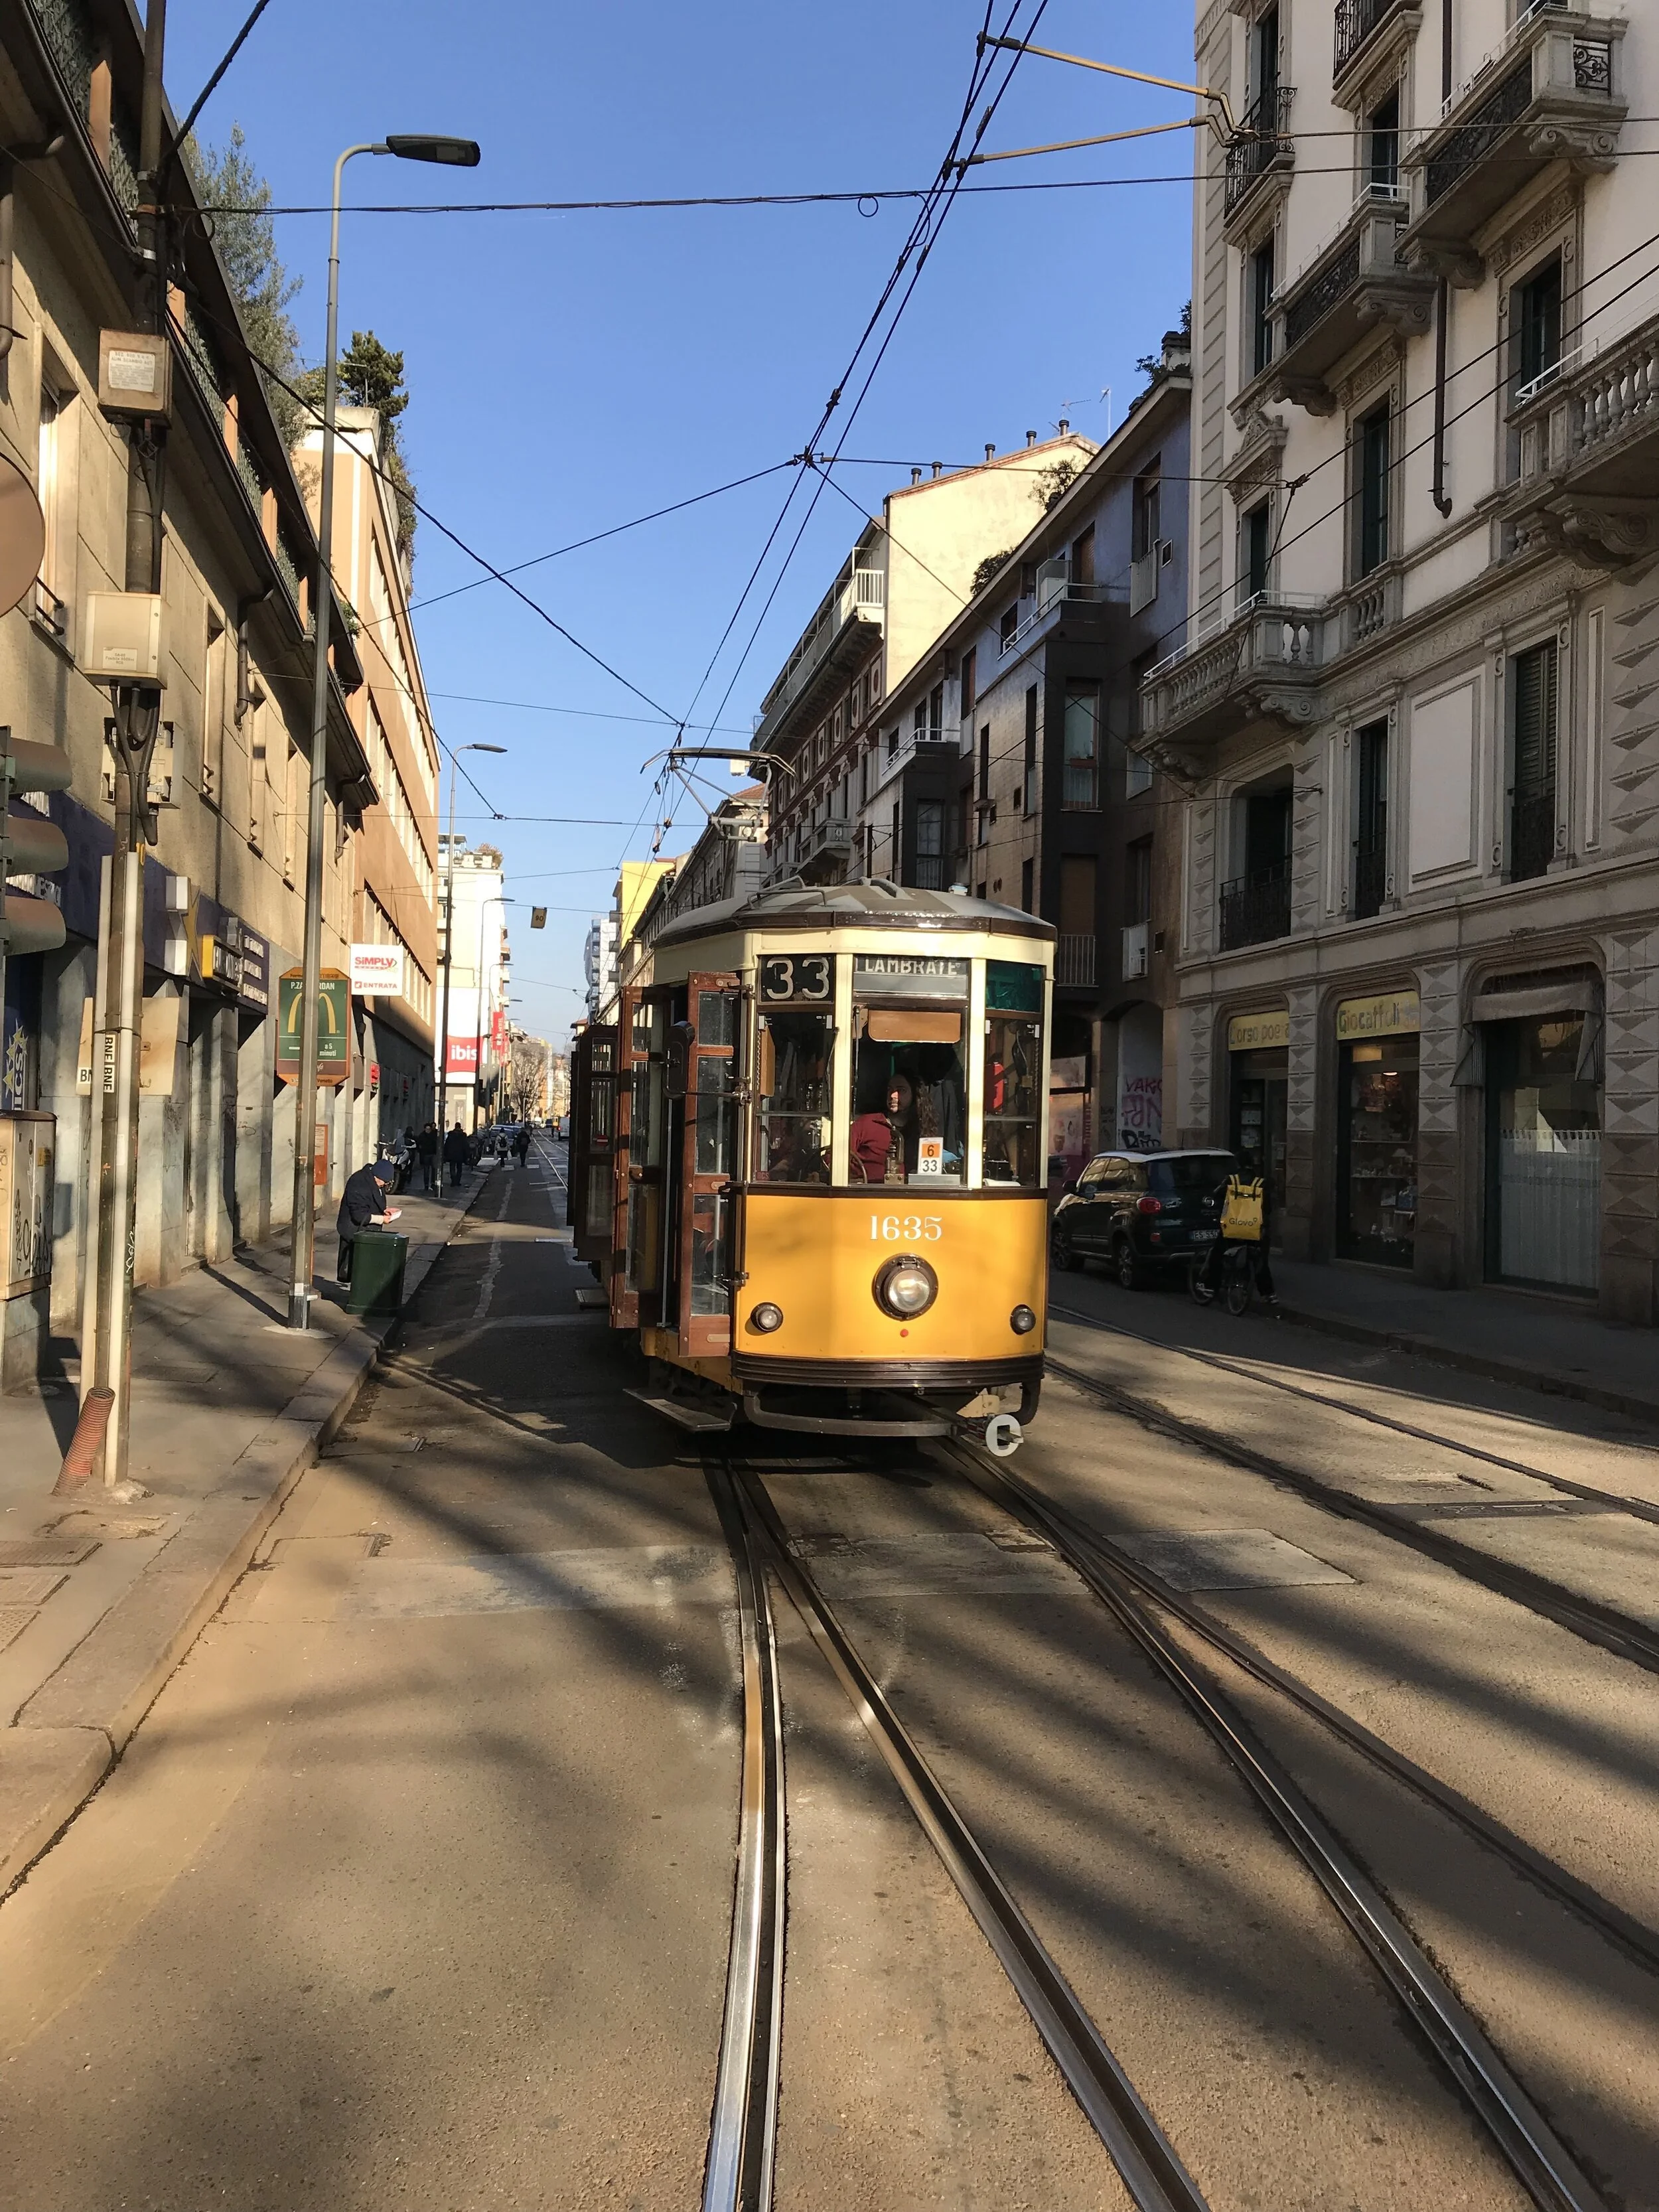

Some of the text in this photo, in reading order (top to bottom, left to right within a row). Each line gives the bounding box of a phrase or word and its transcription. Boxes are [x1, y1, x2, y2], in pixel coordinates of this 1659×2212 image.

[864, 957, 958, 976] LAMBRATE
[765, 956, 830, 999] 33
[1338, 1001, 1401, 1034] Giocattoli
[104, 1037, 113, 1061] BNE
[451, 1045, 477, 1061] ibis
[103, 1067, 113, 1091] BNE
[927, 1144, 935, 1157] 6
[922, 1159, 938, 1172] 33
[869, 1215, 943, 1241] 1635
[1228, 1217, 1255, 1227] Glovo
